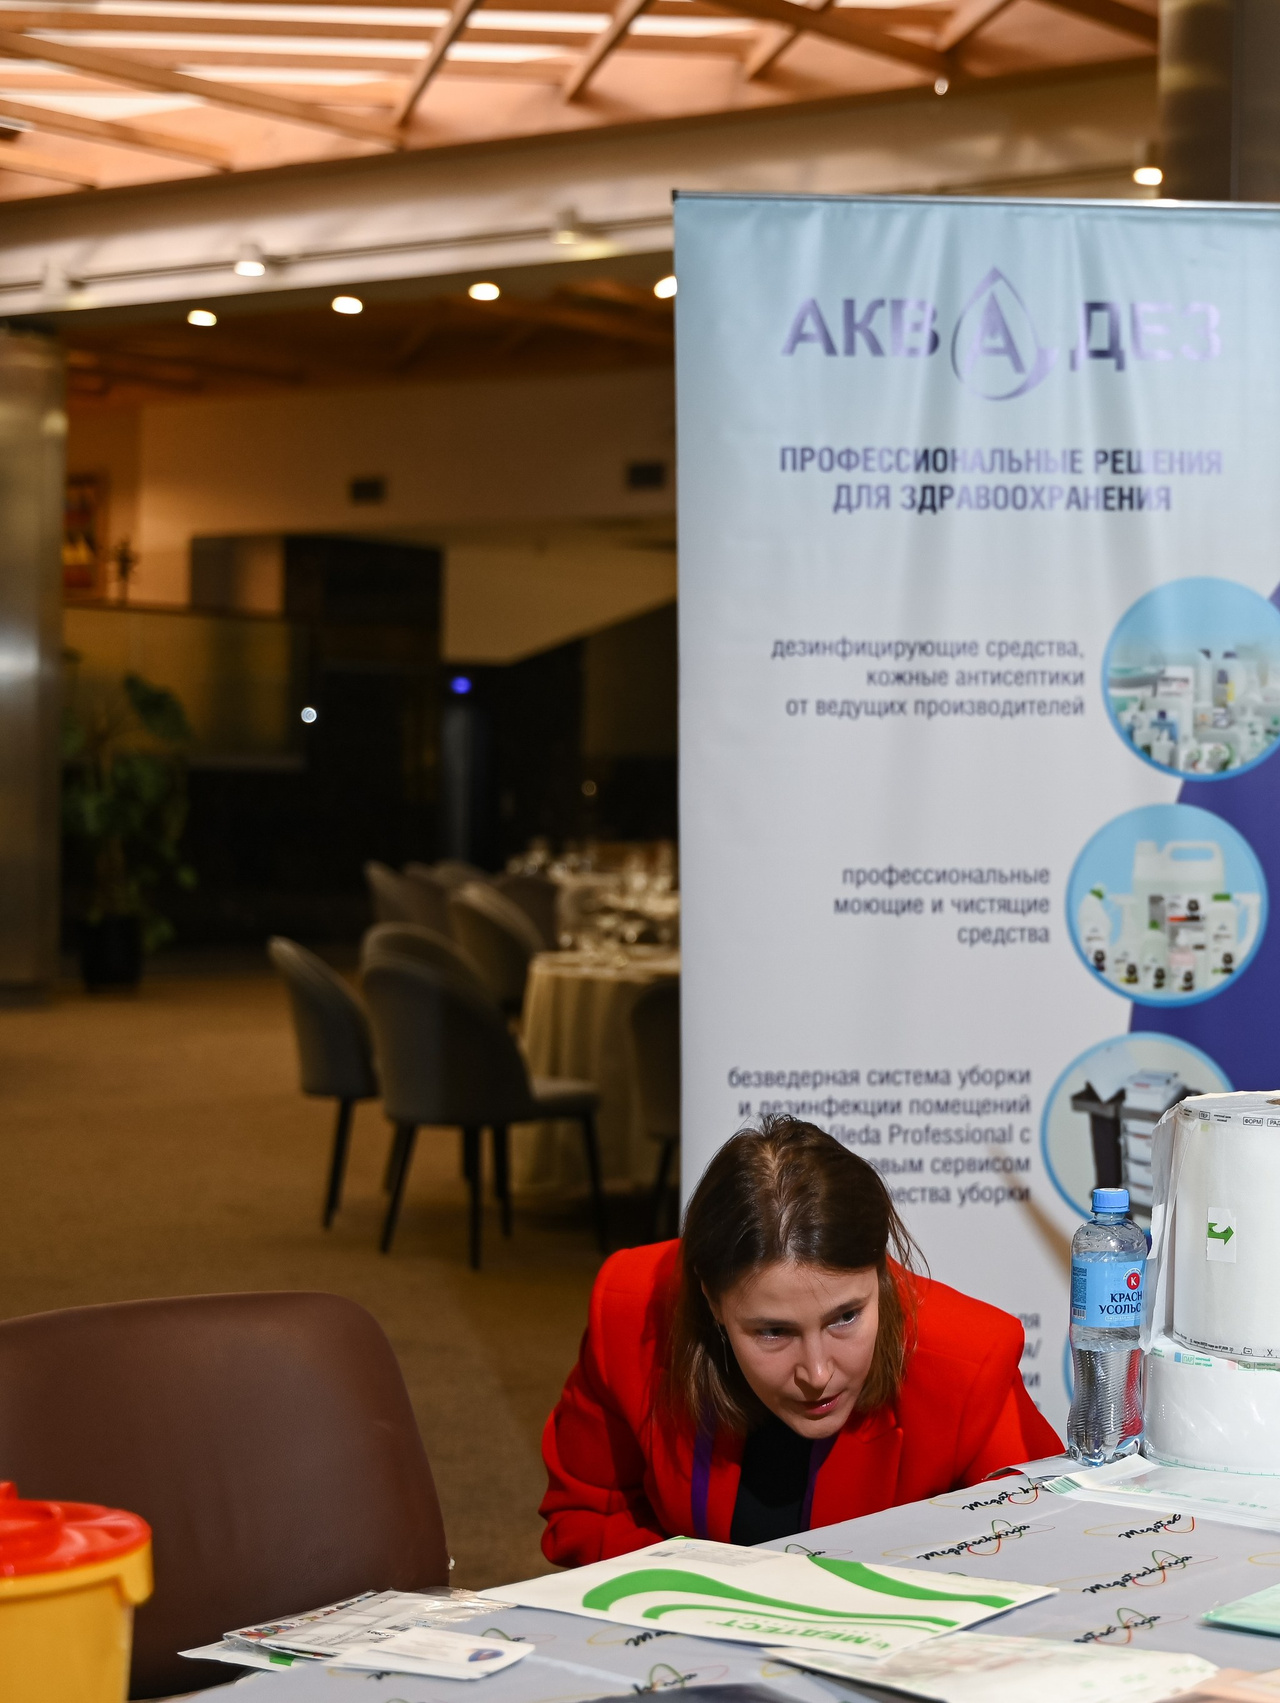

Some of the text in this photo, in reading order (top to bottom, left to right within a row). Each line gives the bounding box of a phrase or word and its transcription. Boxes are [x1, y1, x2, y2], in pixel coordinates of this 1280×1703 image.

[780, 446, 1222, 476] ПРОФЕССИОНАЛЬНЫЕ РЕШЕНИЯ
[833, 484, 1172, 514] ДЛЯ ЗДРАВООХРАНЕНИЯ
[771, 636, 1085, 662] дезинфицирующие средства,
[866, 669, 1085, 687] кожные антисептики
[786, 696, 1084, 720] от ведущих производителей
[842, 864, 1050, 889] профессиональные
[834, 897, 1050, 917] моющие и чистящие
[957, 926, 1050, 948] средства
[728, 1064, 1031, 1090] безведерная система уборки
[738, 1101, 750, 1116] и
[909, 1095, 1031, 1119] помещений
[888, 1123, 1013, 1146] Professional
[931, 1157, 1030, 1177] сервисом
[958, 1183, 1030, 1206] уборки
[1110, 1290, 1142, 1303] КРАСН
[1098, 1303, 1142, 1315] УСОЛЬС
[917, 1525, 1031, 1560] Megatechnica
[1082, 1555, 1192, 1594] Megatechnica
[716, 1619, 870, 1644] МЕДТЕСТ
